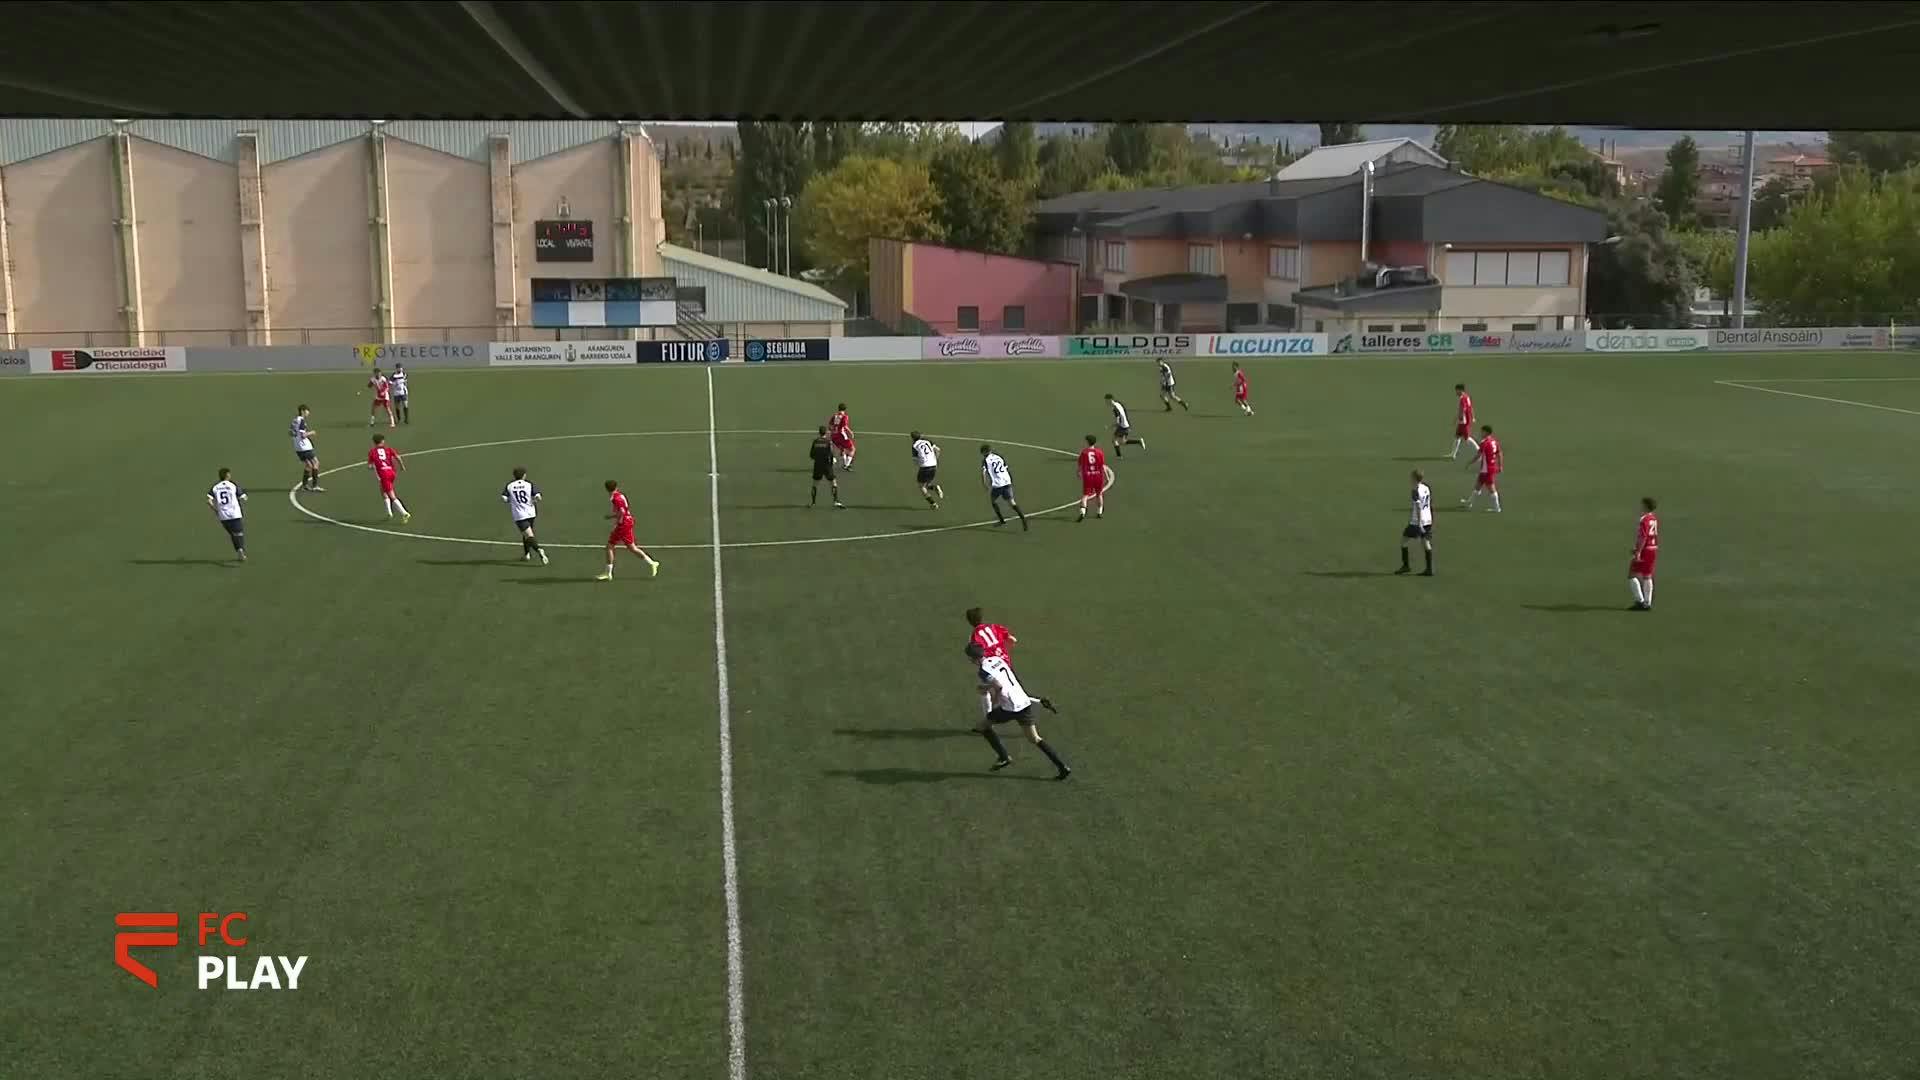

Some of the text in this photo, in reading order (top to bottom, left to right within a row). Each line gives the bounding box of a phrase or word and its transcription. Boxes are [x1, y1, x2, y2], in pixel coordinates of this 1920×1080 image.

[1075, 336, 1190, 349] TOLDOS
[1361, 336, 1421, 348] talleres
[1716, 331, 1761, 343] Dental
[766, 342, 806, 354] SEGUNDA
[1215, 336, 1314, 354] Lacunza
[94, 349, 165, 357] Electricidad
[353, 345, 474, 359] PROYELECTRO
[377, 448, 387, 460] 9
[992, 461, 1005, 474] 22
[220, 491, 229, 505] 5
[513, 490, 528, 504] 18
[979, 626, 999, 647] 11
[1000, 667, 1014, 686] 7
